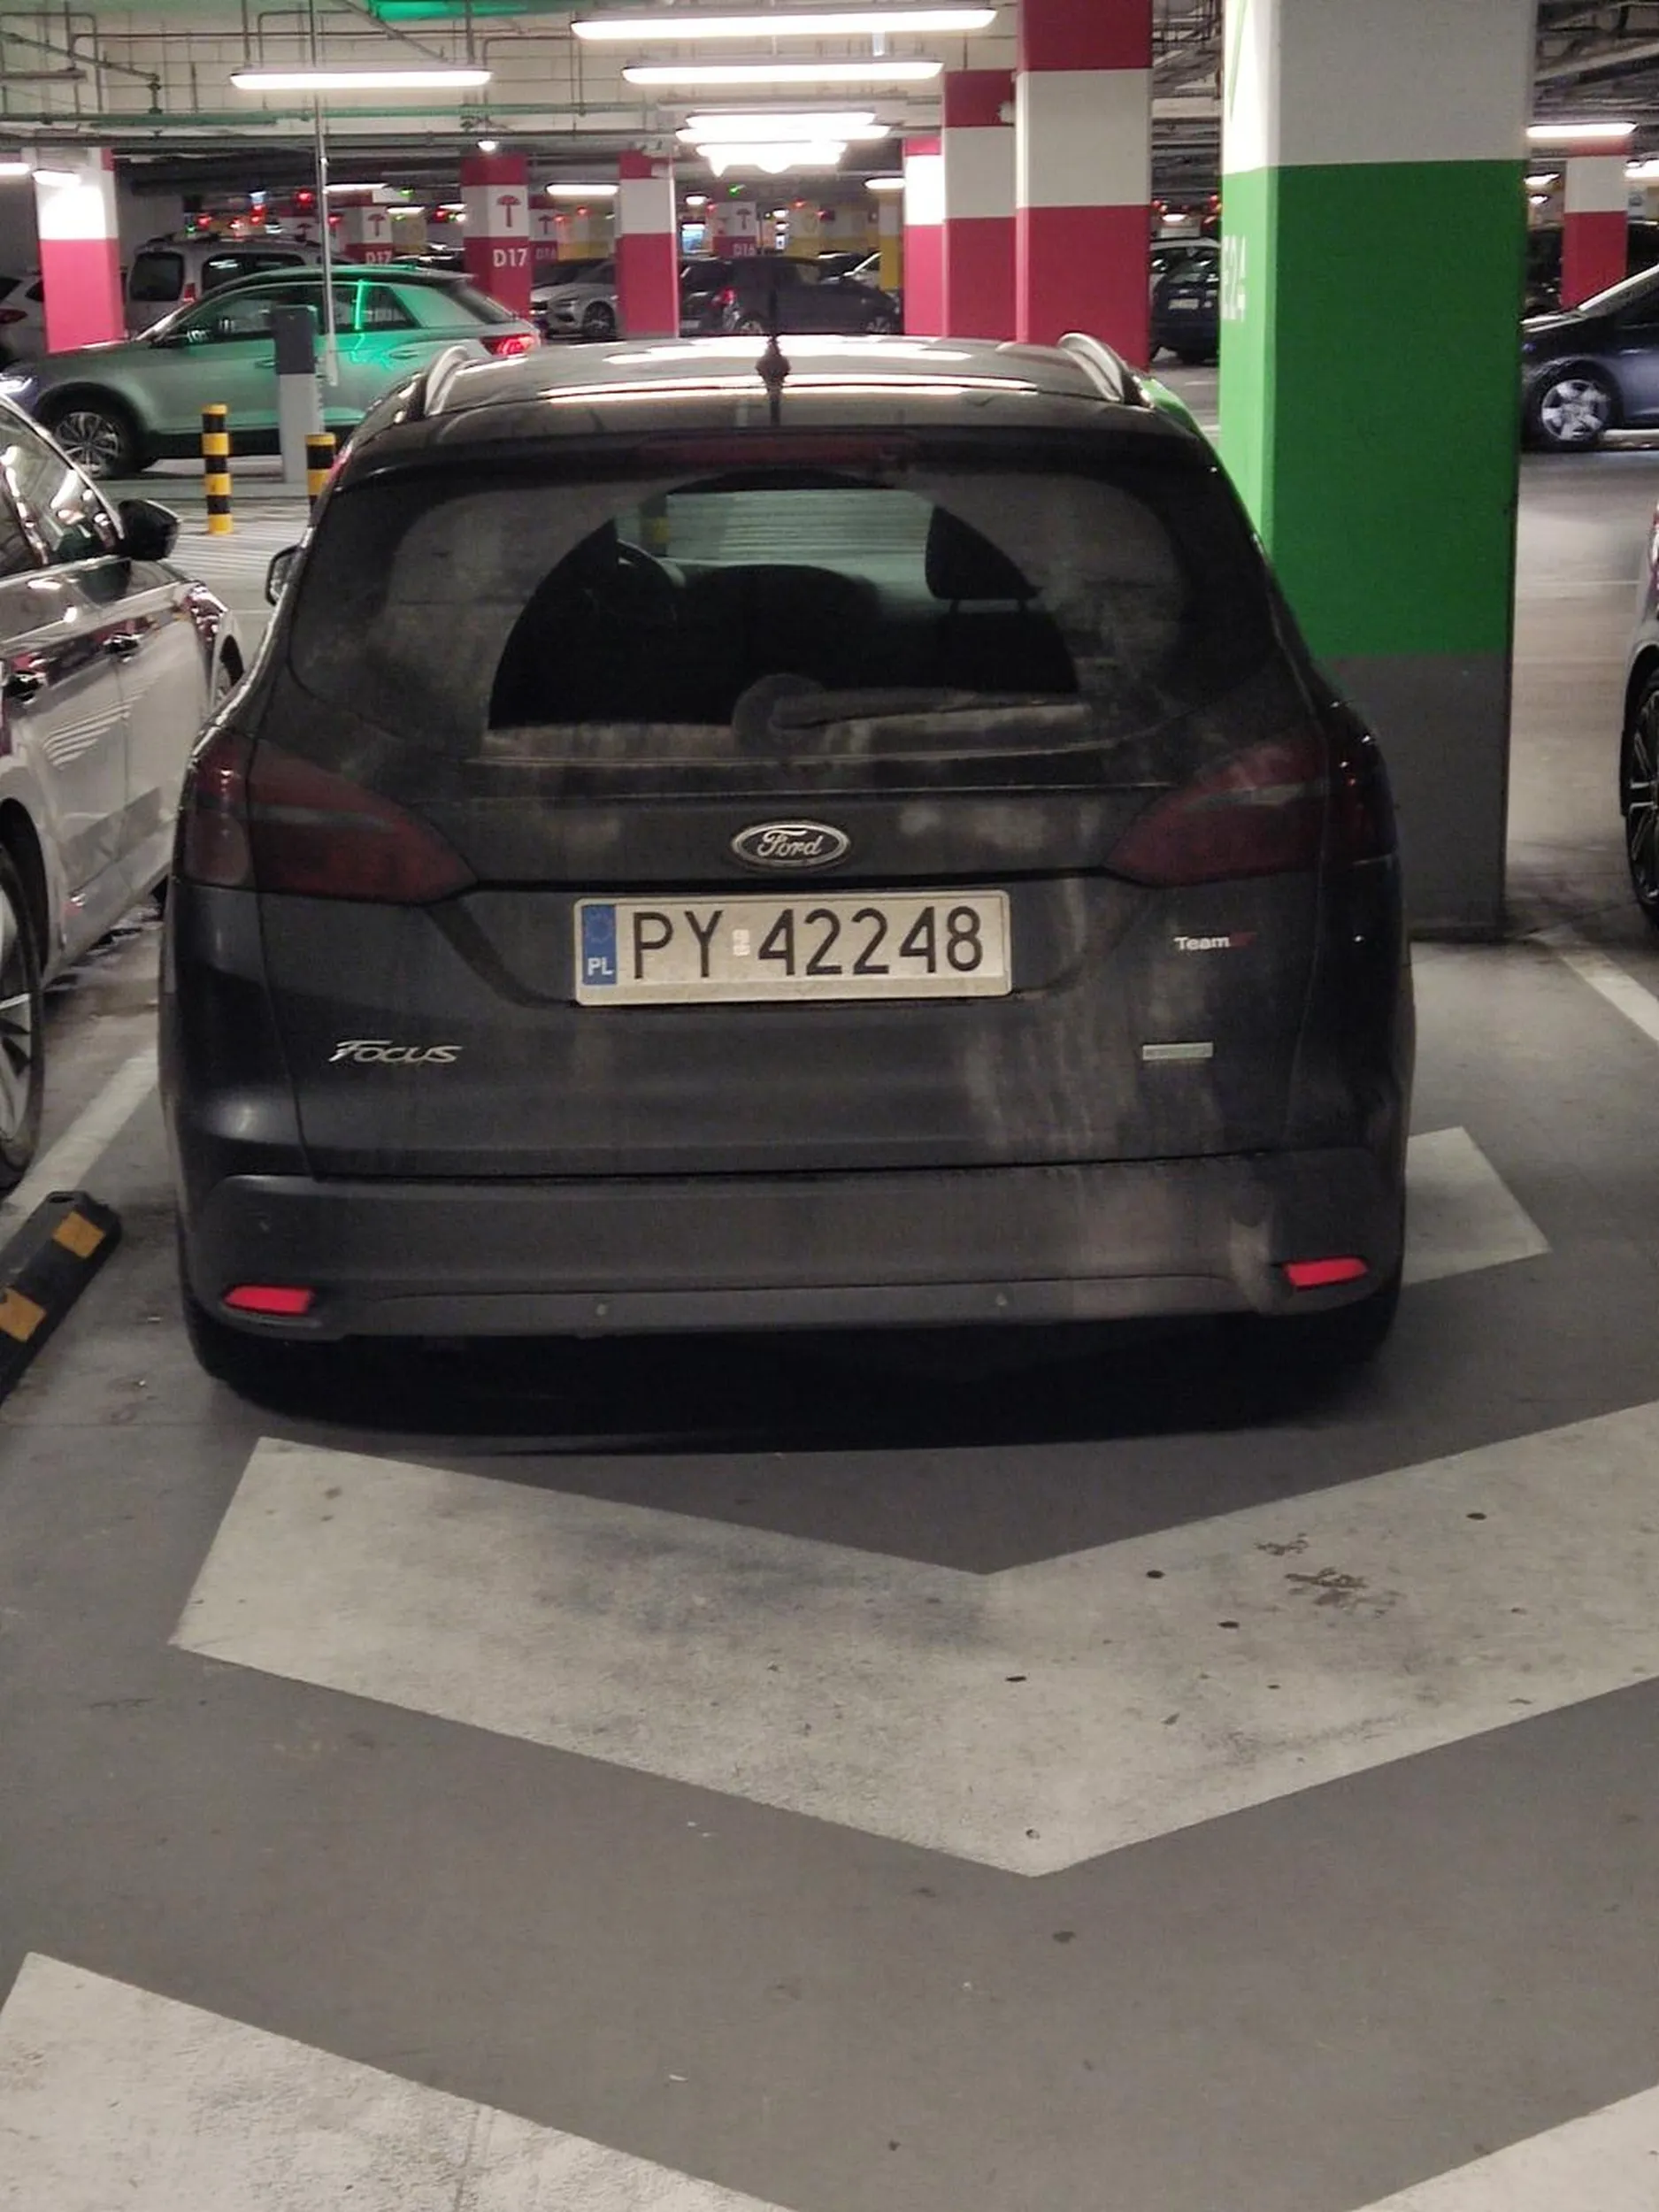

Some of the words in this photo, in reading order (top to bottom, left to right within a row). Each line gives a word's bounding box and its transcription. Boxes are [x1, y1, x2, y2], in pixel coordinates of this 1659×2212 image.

[493, 249, 527, 266] D17
[757, 830, 823, 856] Ford
[633, 910, 723, 979] PY
[758, 906, 983, 976] 42248
[1174, 935, 1231, 950] Team
[588, 956, 613, 975] PL
